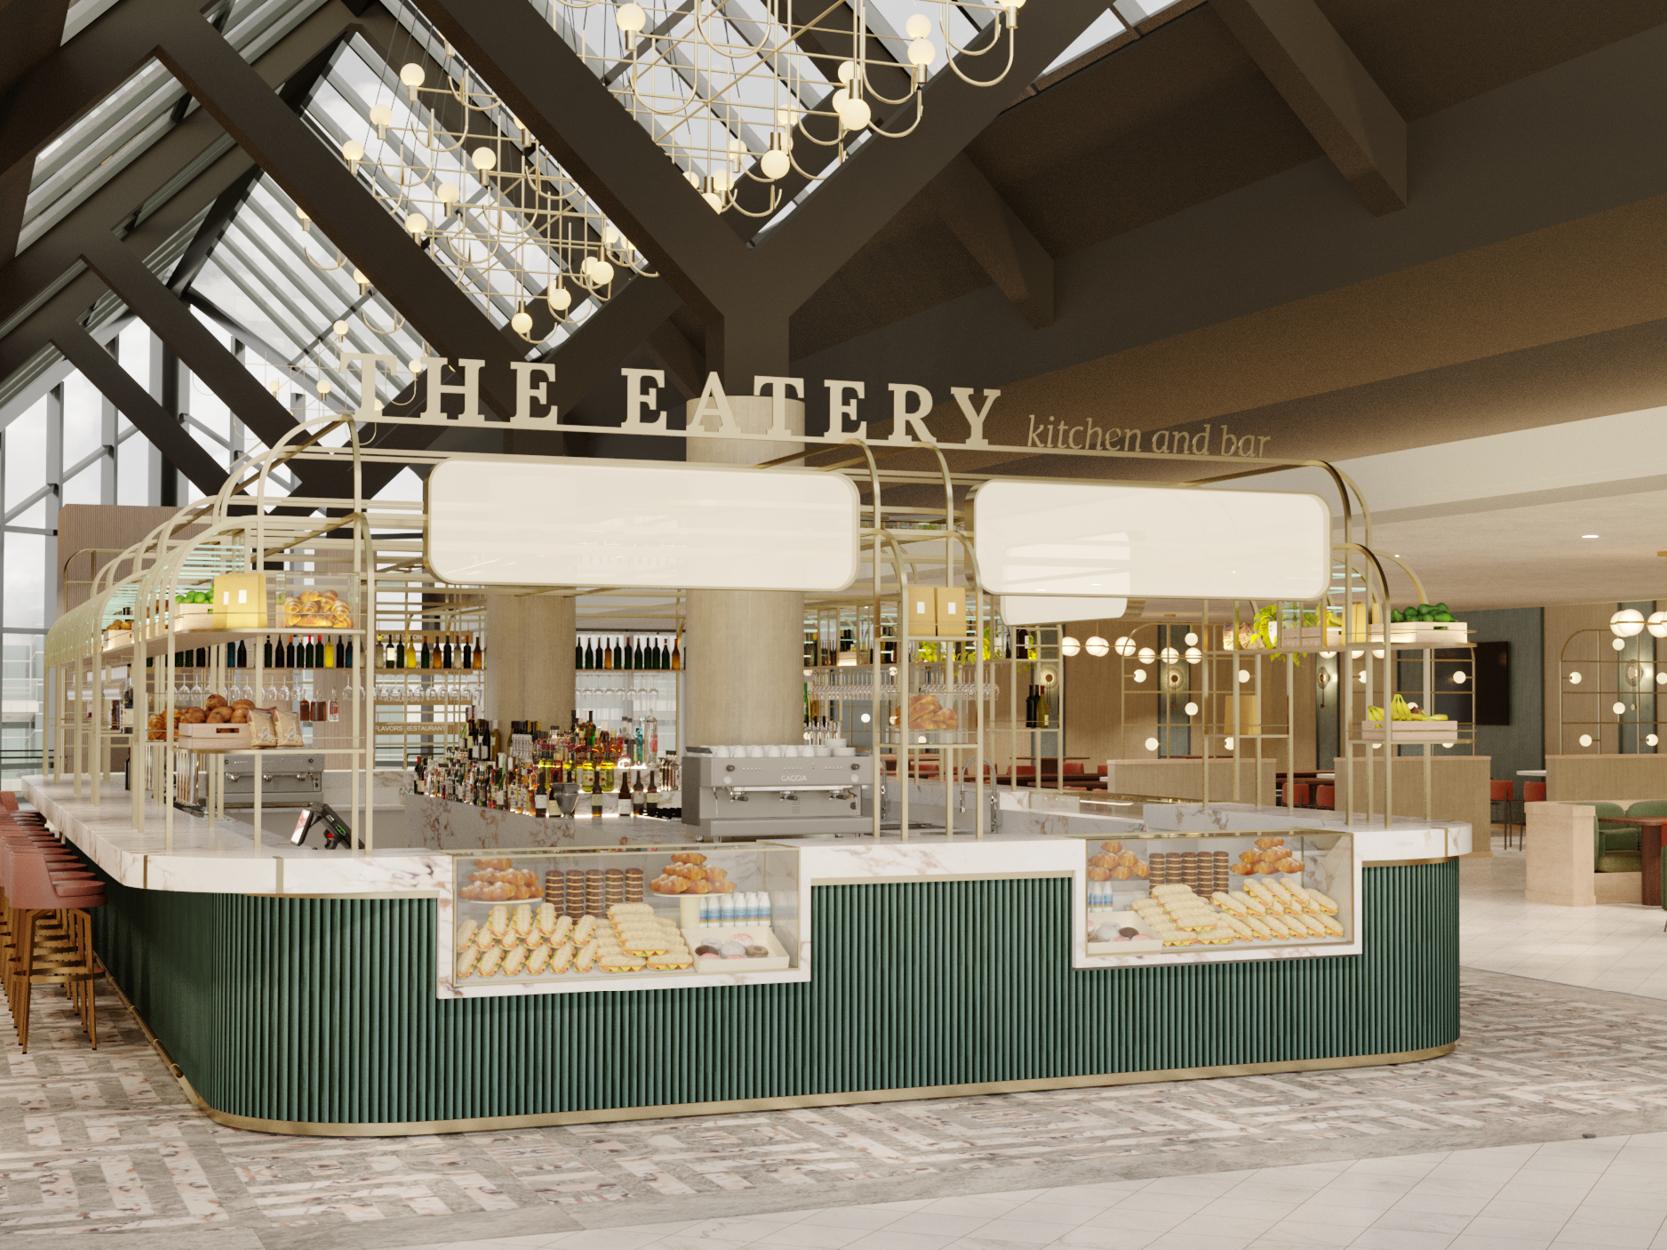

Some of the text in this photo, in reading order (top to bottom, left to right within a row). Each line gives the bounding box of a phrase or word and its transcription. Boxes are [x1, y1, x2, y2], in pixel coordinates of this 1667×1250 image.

[339, 352, 1001, 445] THE EATERY
[1027, 414, 1272, 458] kitchen and bar
